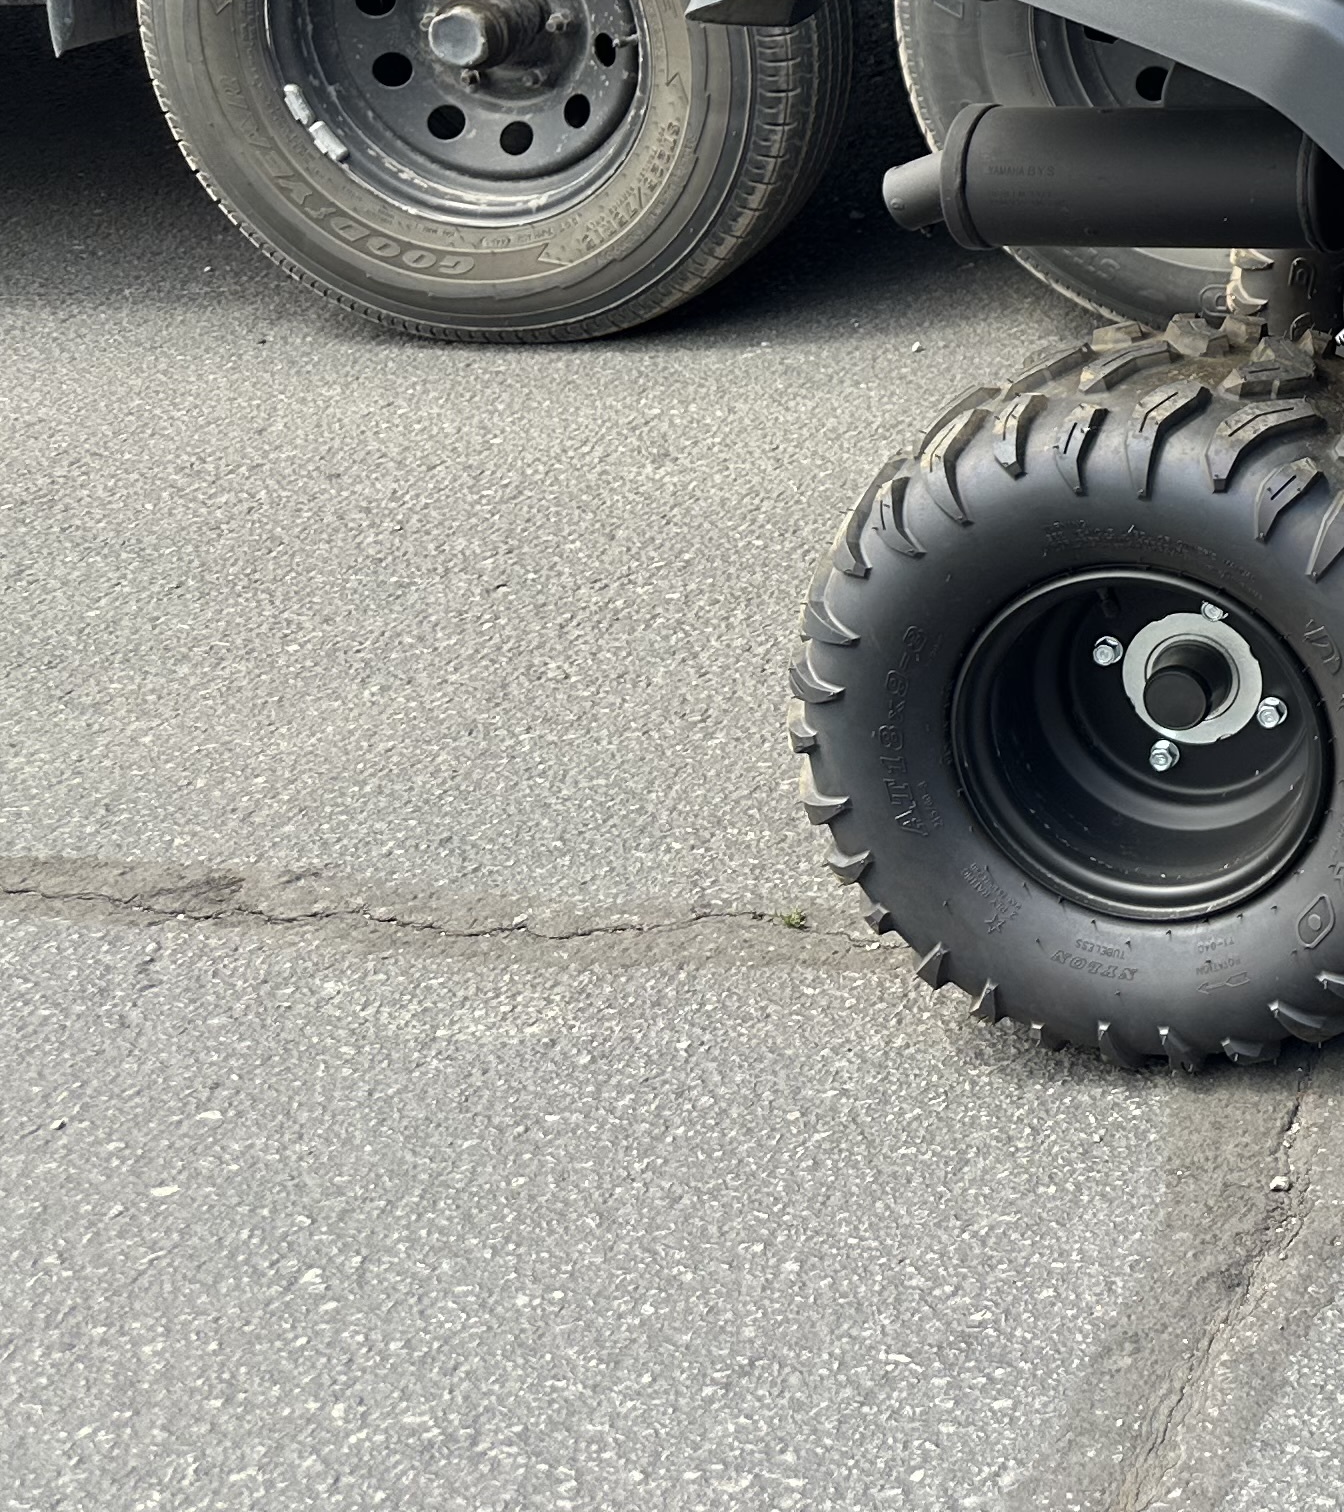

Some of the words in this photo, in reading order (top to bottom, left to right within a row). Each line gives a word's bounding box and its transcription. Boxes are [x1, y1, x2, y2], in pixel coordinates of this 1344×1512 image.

[217, 75, 475, 275] GOODYEAR
[1051, 949, 1138, 981] NYLON
[1075, 938, 1125, 960] TUBELESS
